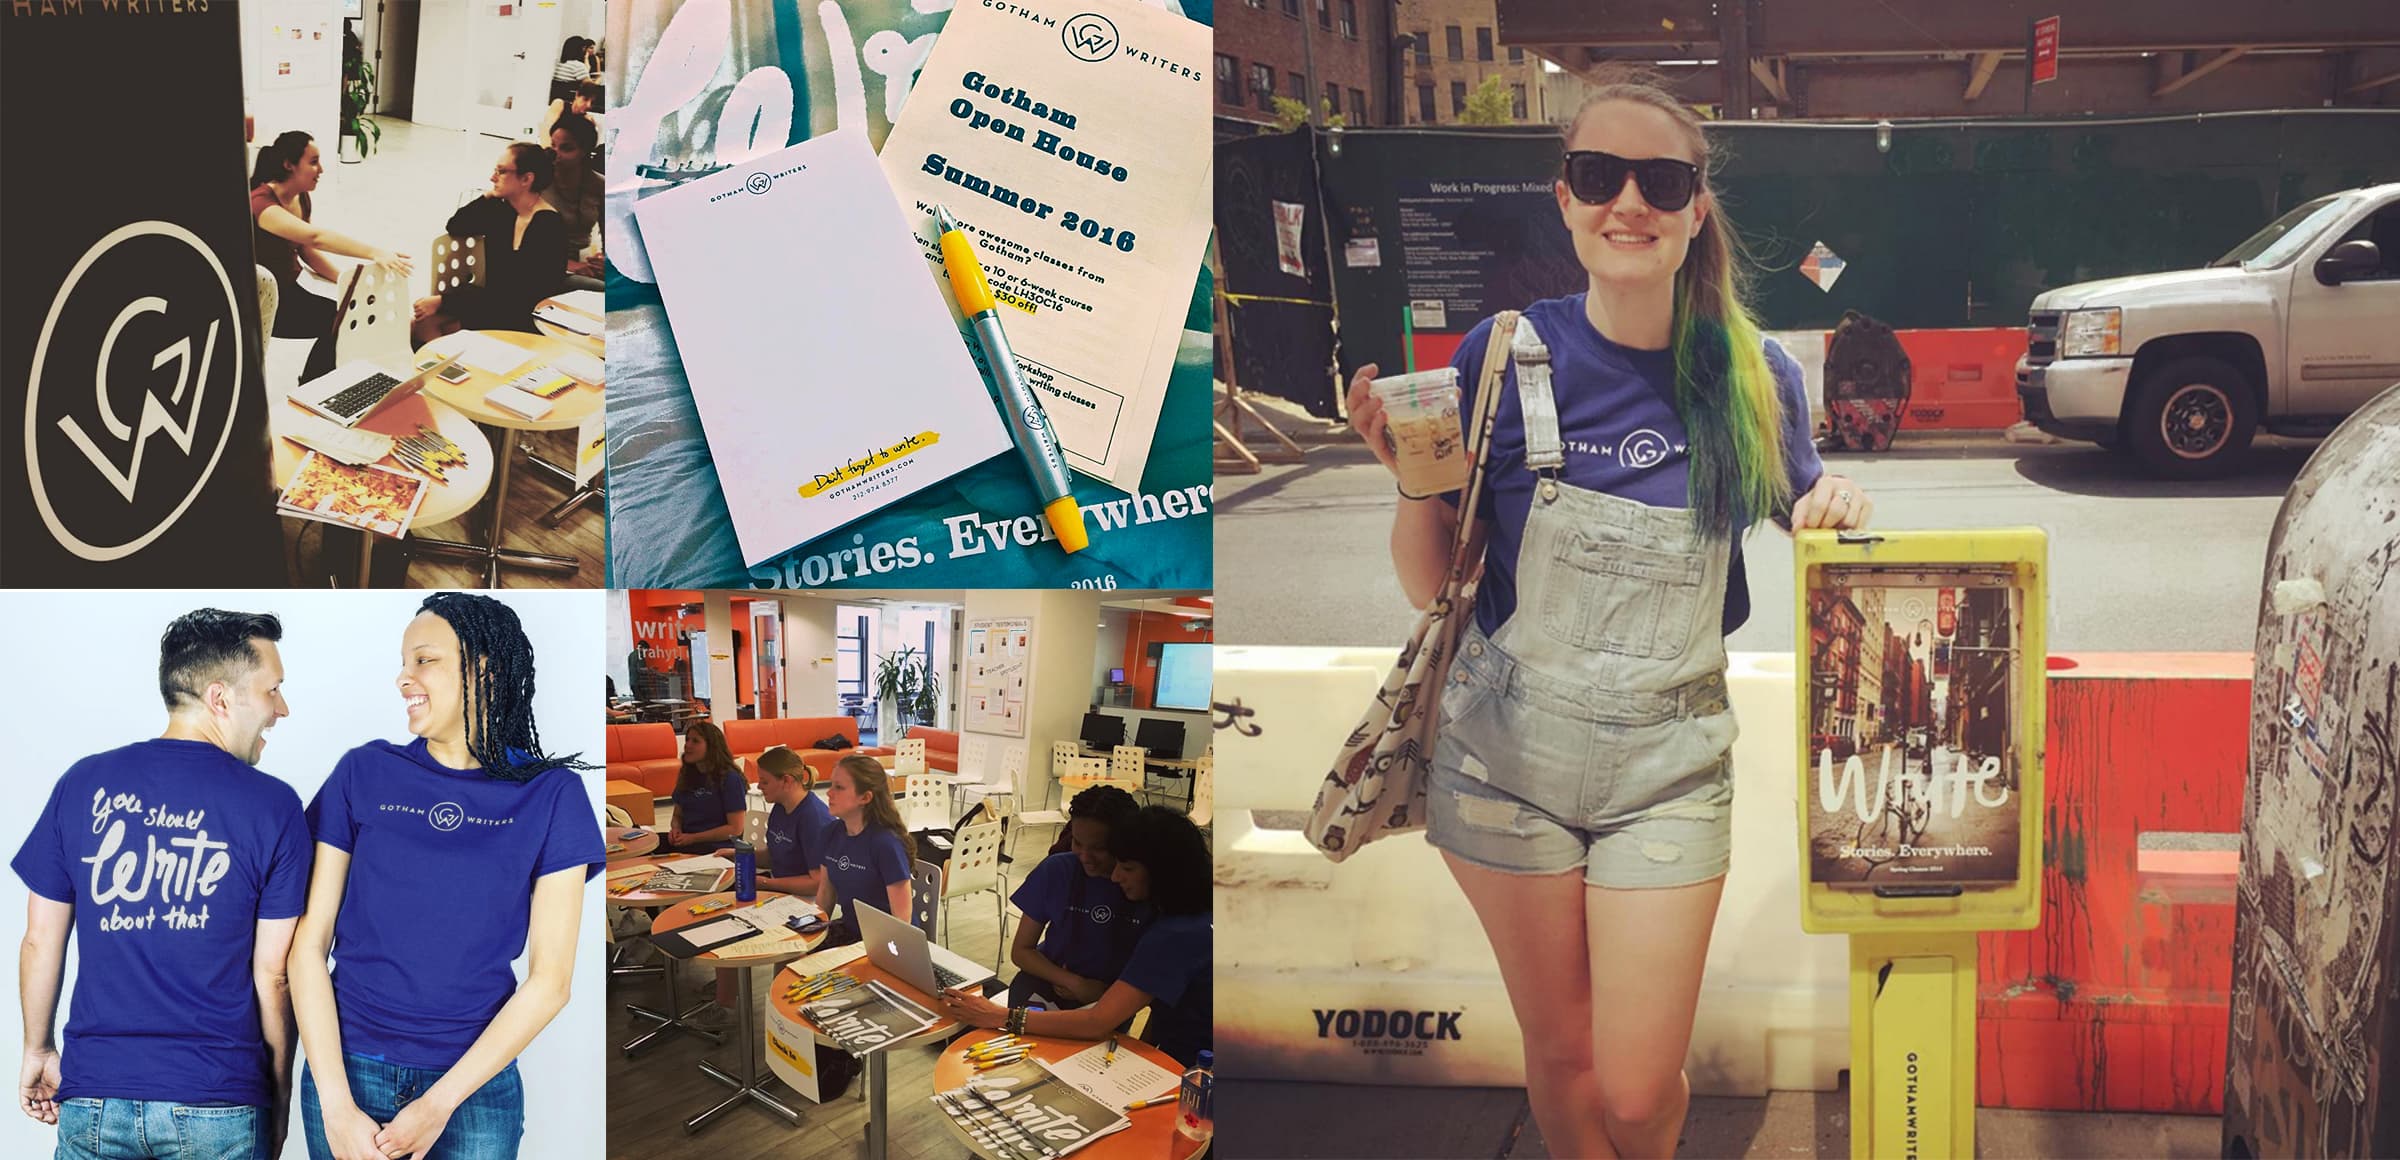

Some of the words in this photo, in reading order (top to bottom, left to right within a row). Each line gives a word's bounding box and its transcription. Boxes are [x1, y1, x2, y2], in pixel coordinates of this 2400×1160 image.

[983, 0, 1056, 28] GOTHAM
[1126, 46, 1202, 82] WRITERS
[962, 71, 1077, 130] Gotham
[950, 98, 1024, 143] Open
[1032, 130, 1128, 182] House
[710, 187, 744, 203] GOTHAM
[773, 164, 808, 180] WRITERS
[1430, 182, 1458, 193] Work
[1460, 182, 1471, 192] in
[1473, 182, 1521, 195] Progress:
[1523, 182, 1553, 193] Mixed
[921, 153, 1054, 220] Summer
[1060, 211, 1136, 252] 2016
[979, 238, 1032, 265] Gotham?
[979, 229, 1030, 254] awesome
[1033, 251, 1074, 272] classes
[1077, 267, 1105, 285] from
[924, 252, 944, 265] and
[987, 277, 1012, 293] code
[993, 265, 1006, 277] 10
[1007, 274, 1019, 284] or
[1020, 276, 1057, 299] 6-week
[1058, 293, 1093, 313] course
[994, 289, 1016, 305] $30
[1017, 300, 1039, 315] off!
[1015, 360, 1054, 382] orkshop
[1029, 377, 1062, 398] writing
[1062, 391, 1097, 410] classes
[847, 448, 875, 477] forget
[879, 447, 889, 459] to
[829, 458, 915, 500] GOTHAMWRITERS.COM
[748, 532, 935, 590] Stories.
[635, 616, 699, 641] write
[1819, 746, 2009, 823] Write
[143, 804, 205, 830] should
[379, 803, 425, 816] GOTHAM
[467, 815, 514, 827] WRITERS
[1839, 844, 1895, 859] Stories.
[1899, 843, 1993, 860] Everywhere.
[100, 903, 156, 932] about
[161, 903, 210, 931] that
[1312, 1009, 1462, 1040] YODOCK
